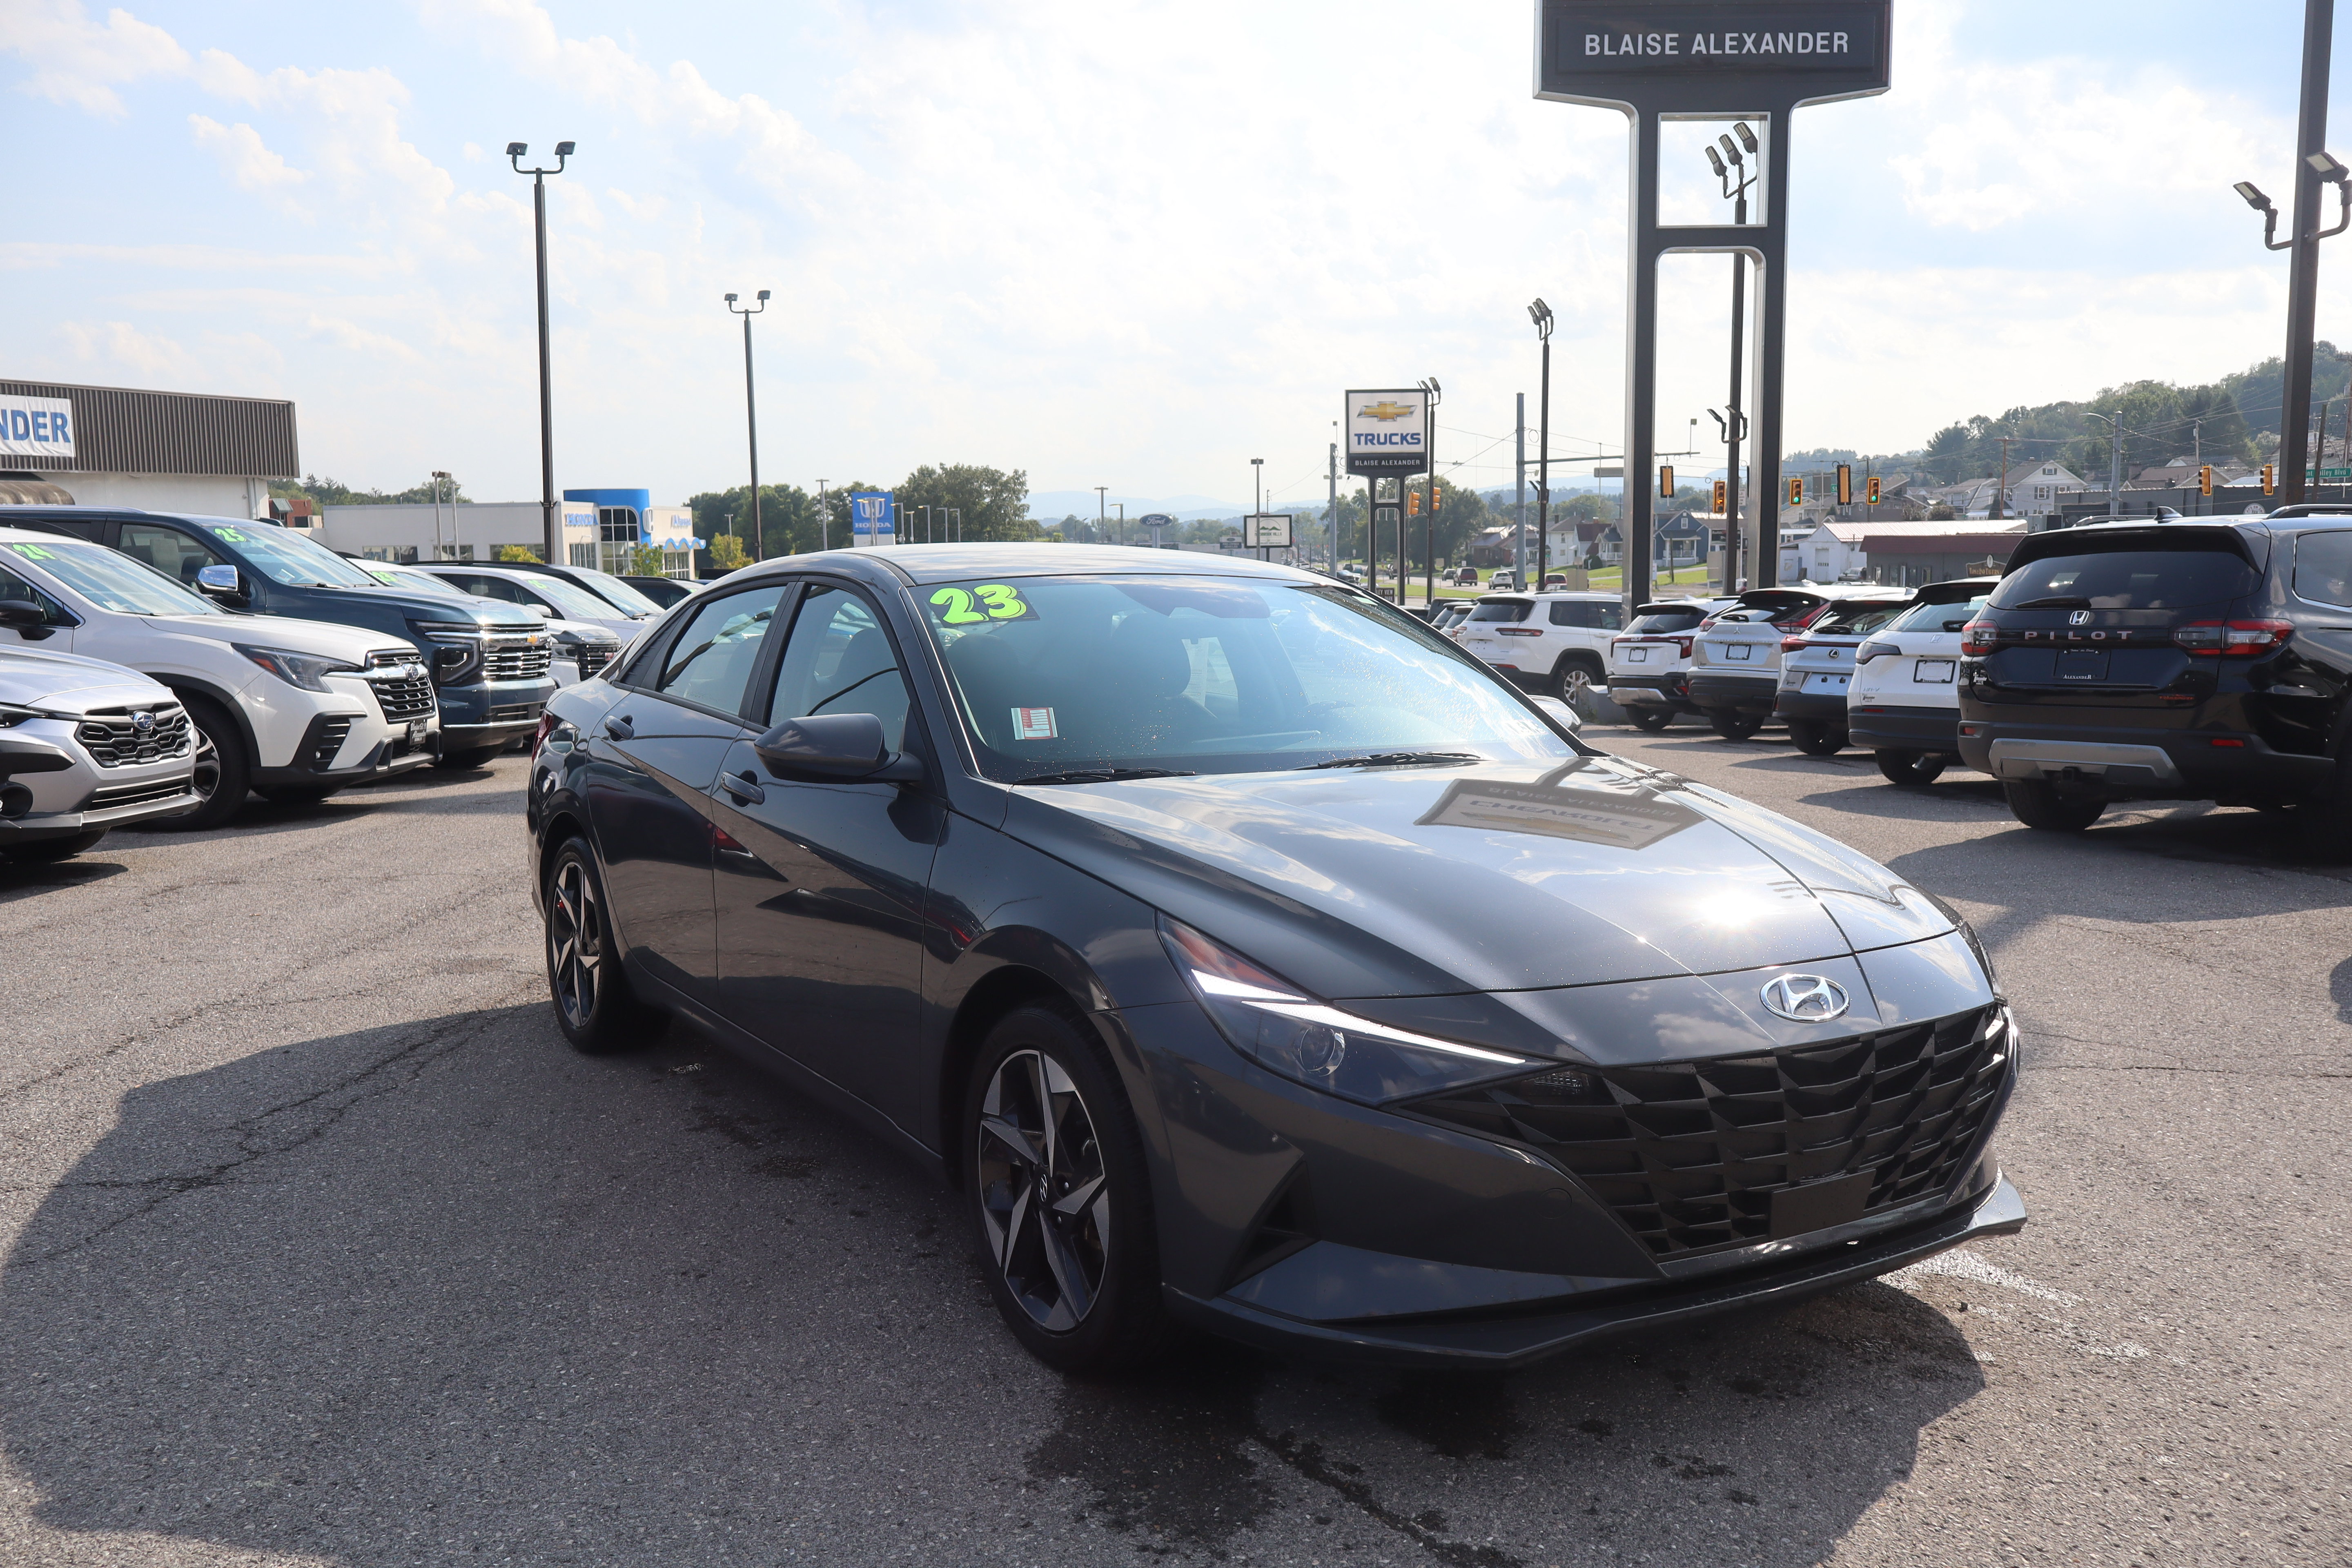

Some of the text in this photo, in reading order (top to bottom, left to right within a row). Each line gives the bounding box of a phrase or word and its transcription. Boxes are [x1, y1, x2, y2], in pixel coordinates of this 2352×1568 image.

[1585, 32, 1849, 56] BLAISE ALEXANDER
[0, 409, 71, 443] NDER
[1354, 433, 1421, 445] TRUCKS
[566, 513, 598, 526] HONDA
[1146, 516, 1166, 525] Ford
[214, 528, 247, 542] 25
[12, 544, 57, 560] 24
[929, 584, 1027, 624] 23
[2025, 631, 2132, 640] PILOT
